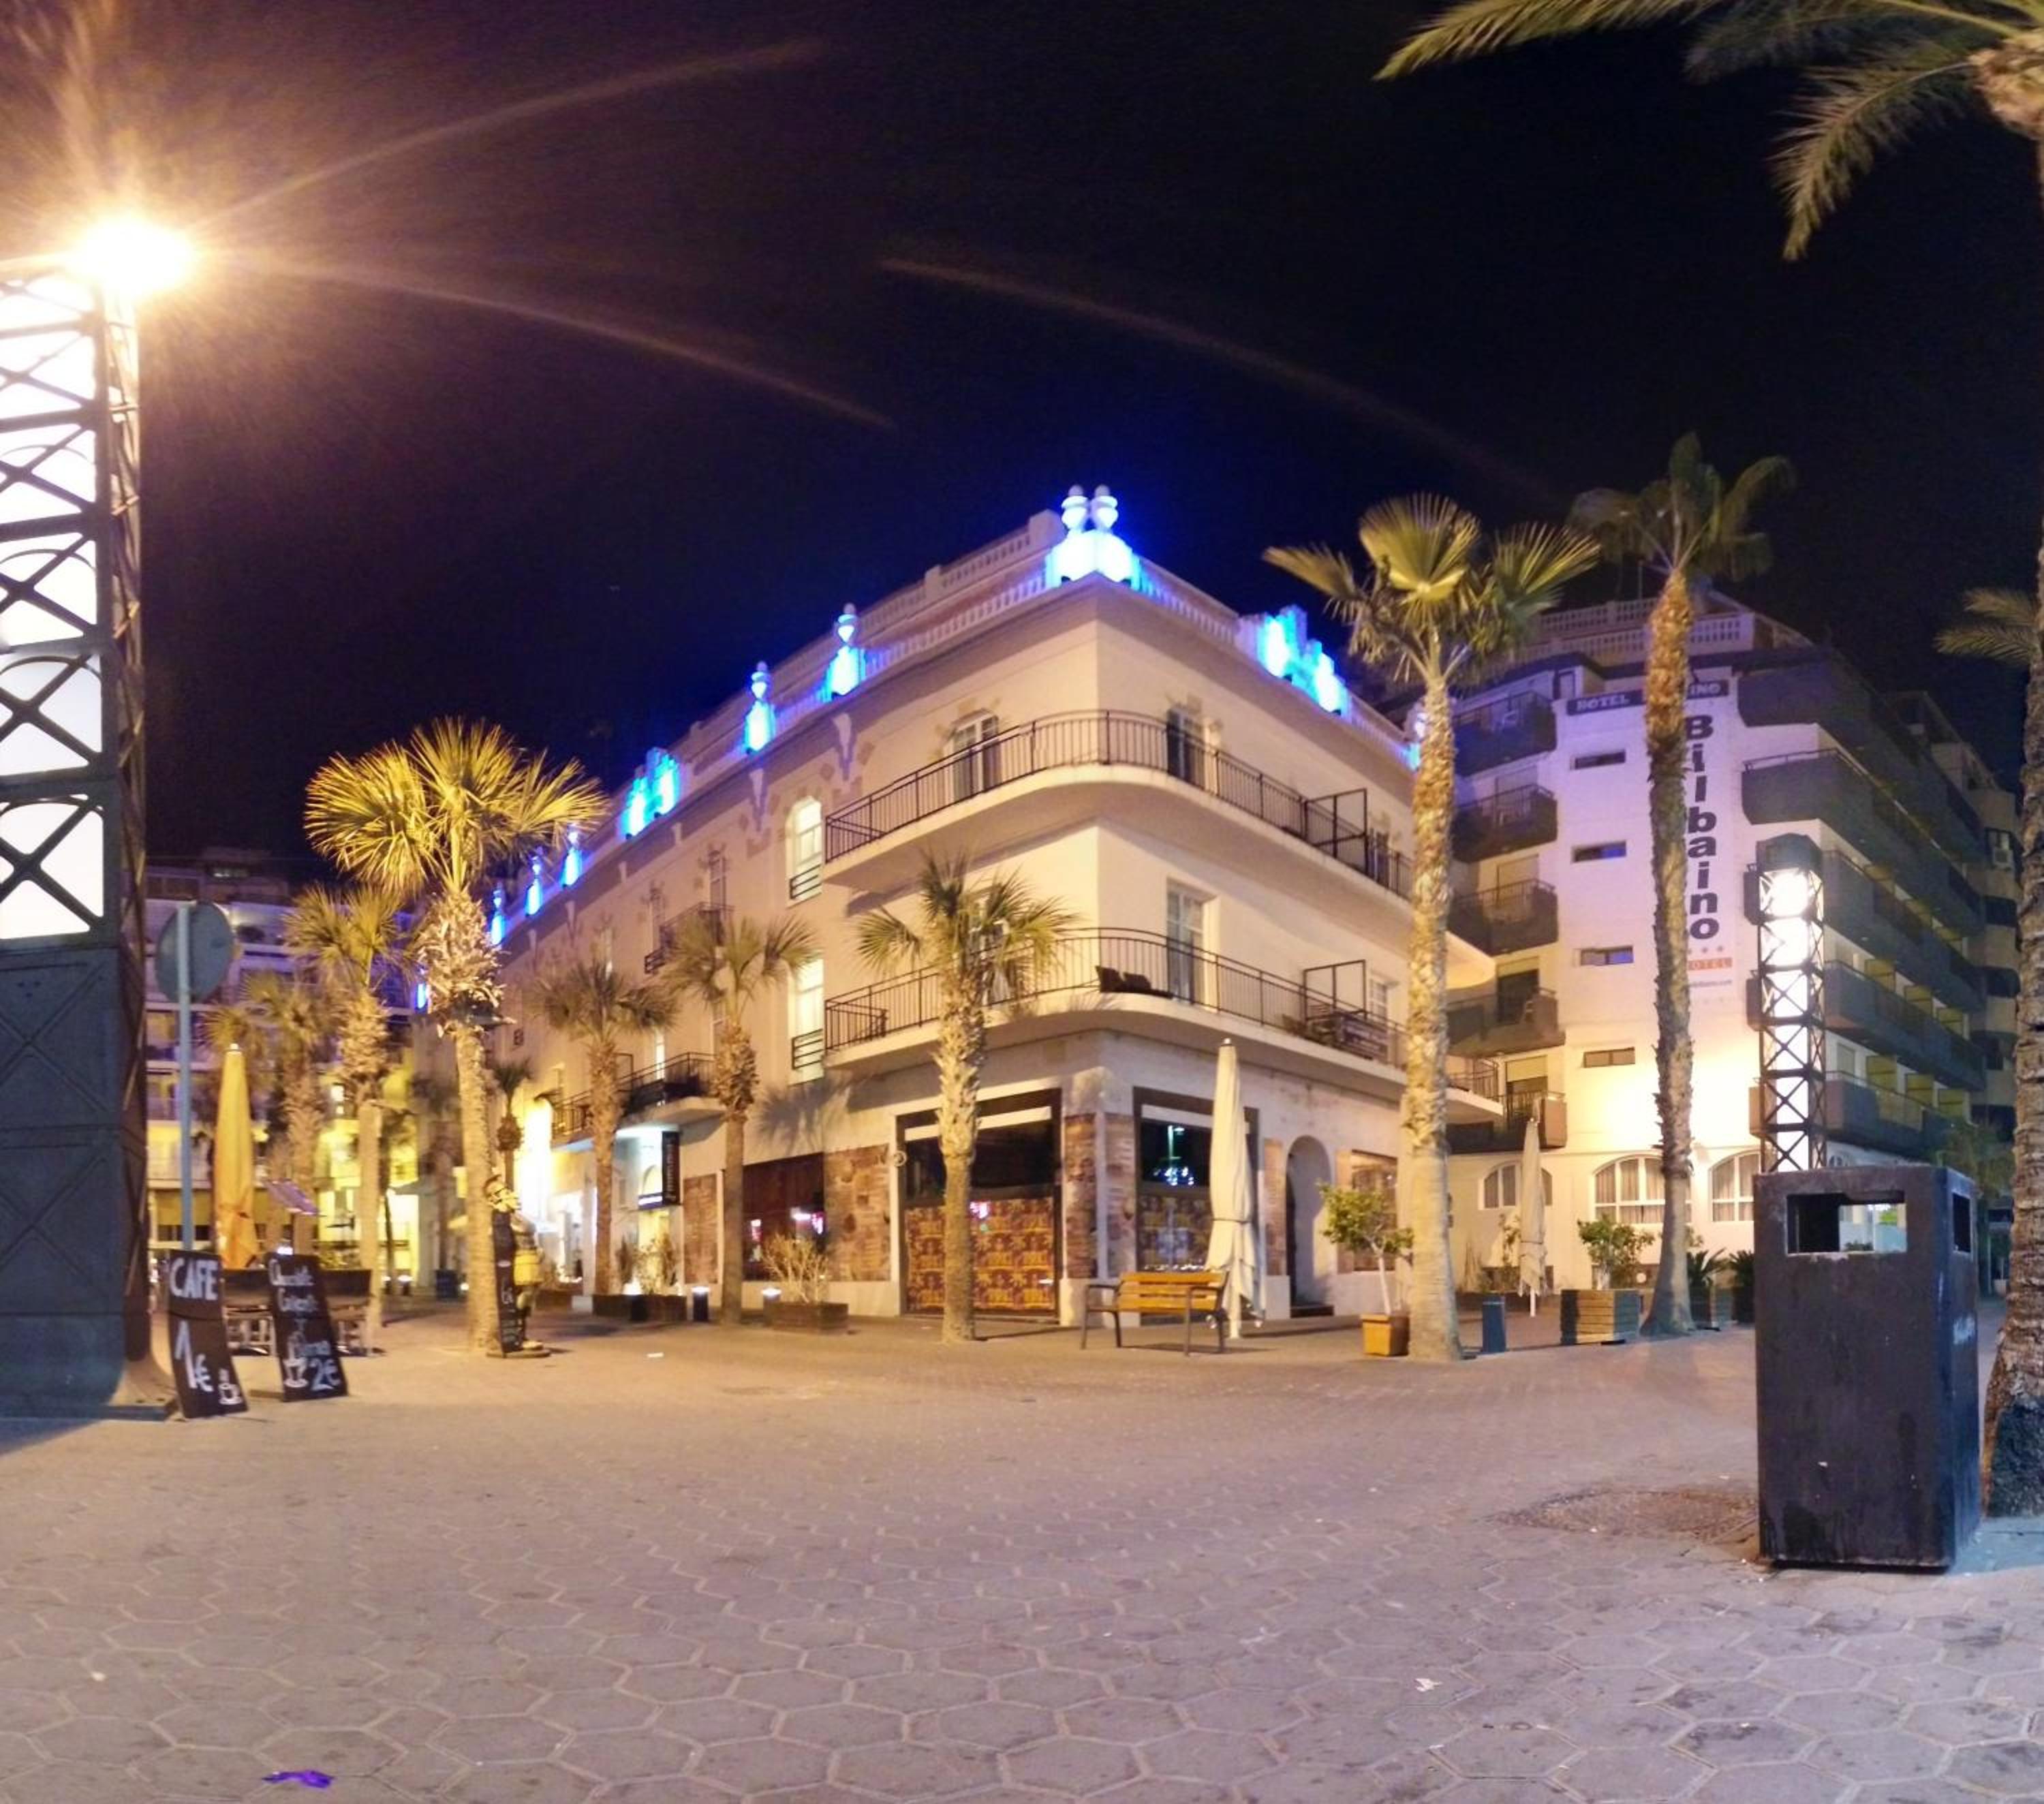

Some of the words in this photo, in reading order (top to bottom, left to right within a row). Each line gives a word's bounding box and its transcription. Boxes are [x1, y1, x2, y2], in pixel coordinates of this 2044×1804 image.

[1576, 694, 1630, 712] HOTEL
[1685, 715, 1720, 940] Bilbaino
[1688, 958, 1732, 970] OTEL
[170, 1258, 219, 1301] CAFE
